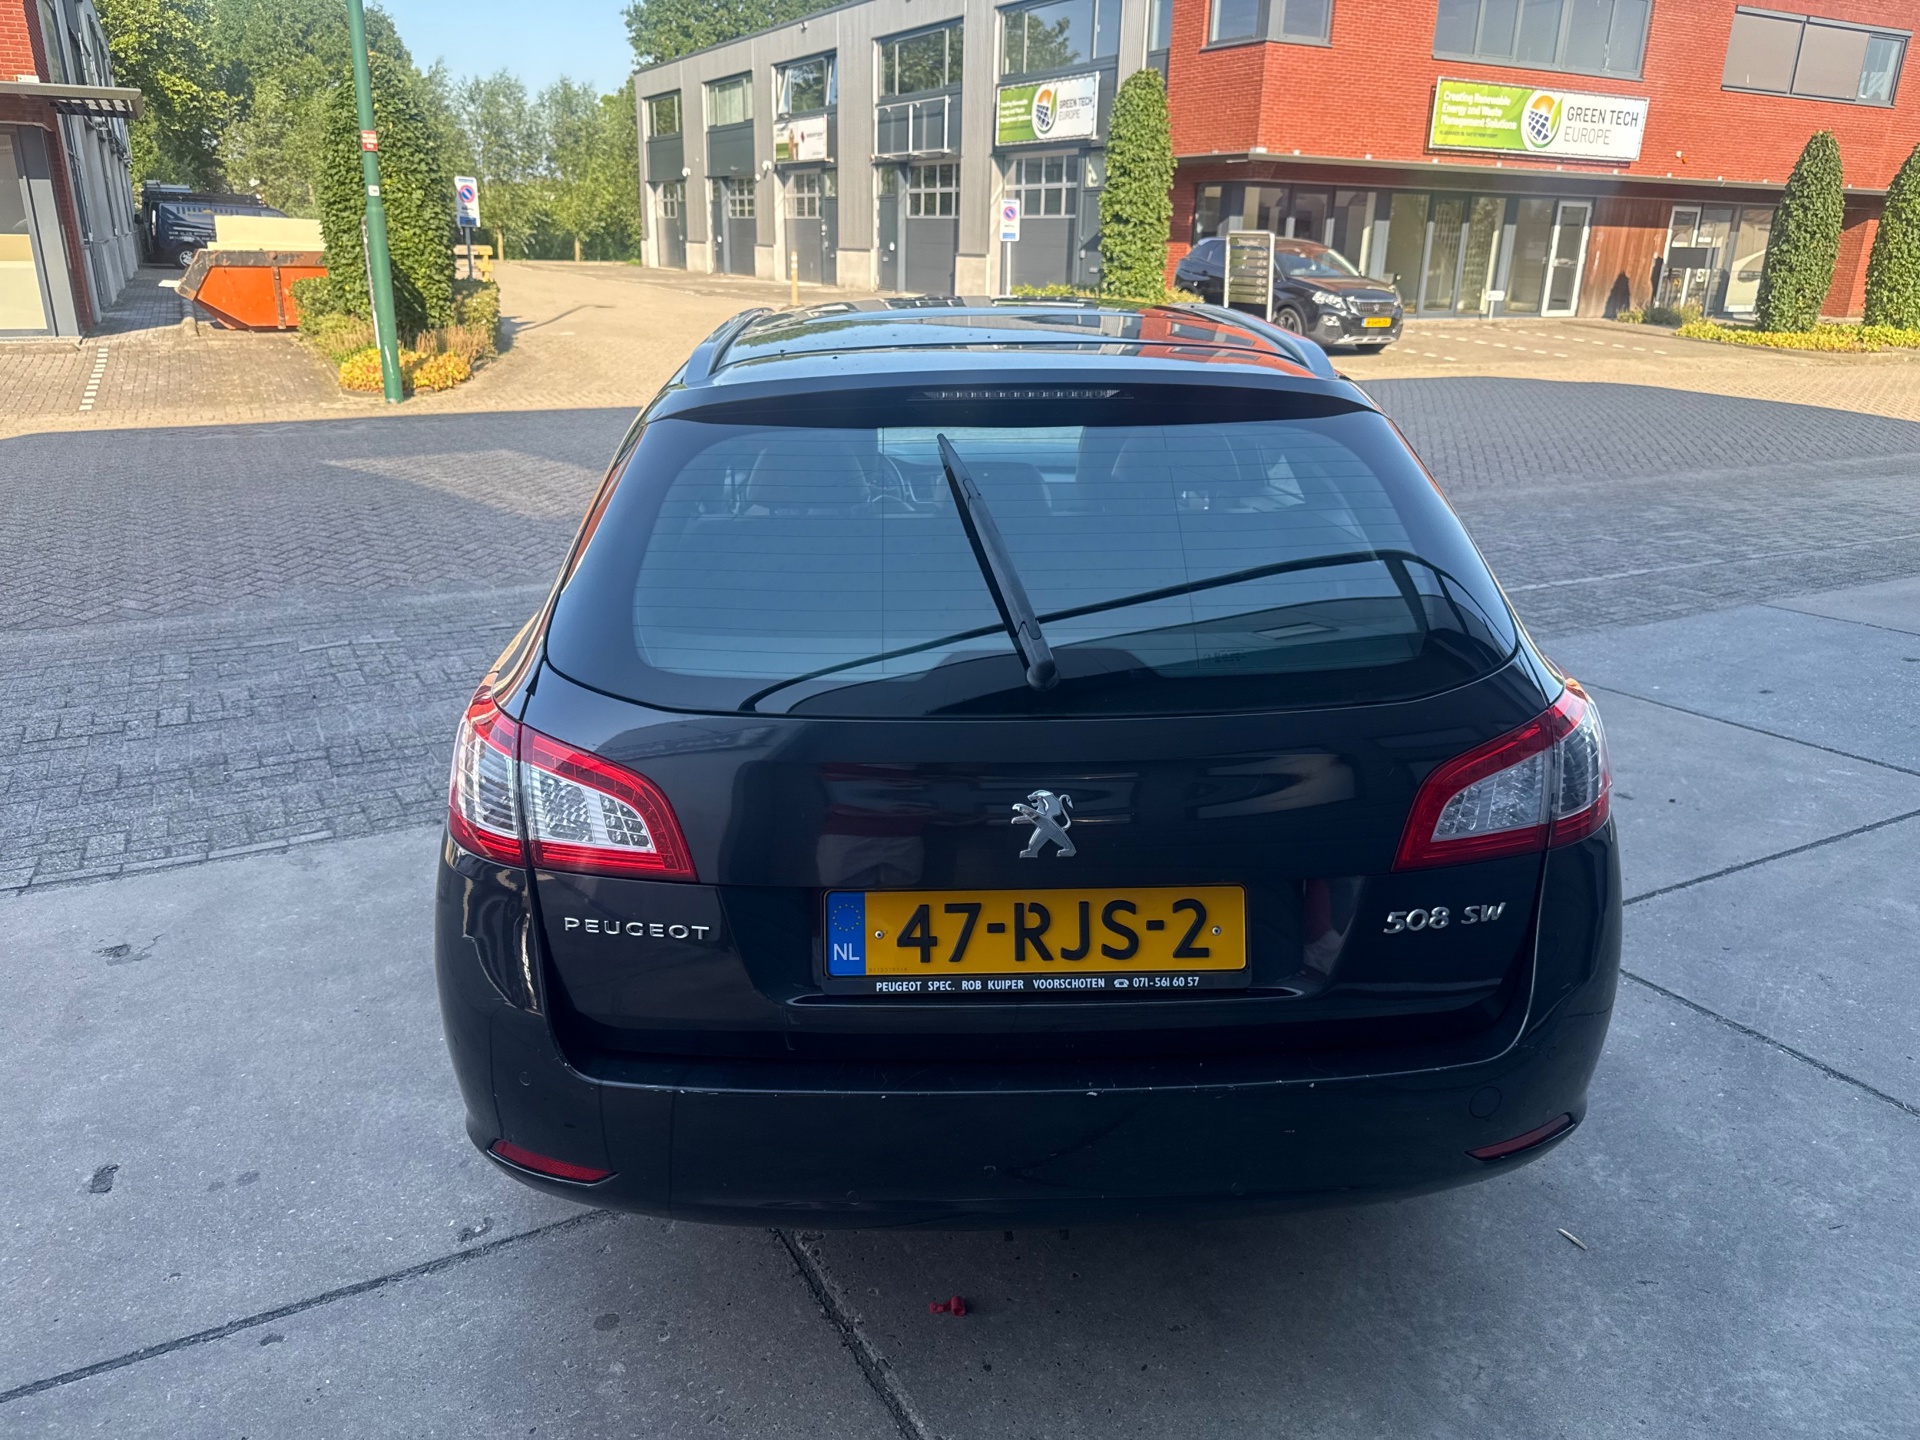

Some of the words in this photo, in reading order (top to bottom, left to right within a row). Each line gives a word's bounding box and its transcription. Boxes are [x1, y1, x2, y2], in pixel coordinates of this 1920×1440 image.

[1443, 90, 1474, 105] Creating
[1441, 102, 1466, 116] Energy
[1467, 106, 1480, 115] and
[1567, 106, 1606, 124] GREEN
[1609, 110, 1639, 127] TECH
[1485, 118, 1517, 130] Solutions
[1564, 126, 1611, 145] EUROPE
[1383, 906, 1450, 934] 508
[1460, 902, 1506, 924] SW
[564, 917, 710, 940] PEUGEOT
[896, 898, 1210, 963] 47-RJS-2
[833, 943, 860, 961] NL
[876, 981, 922, 992] PEUGEOT
[928, 980, 955, 991] SPEC.
[961, 980, 982, 990] ROB
[987, 979, 1024, 990] KUIPER
[1032, 978, 1105, 989] VOORSCHOTEN
[1172, 976, 1185, 987] 60
[1187, 976, 1199, 987] 57
